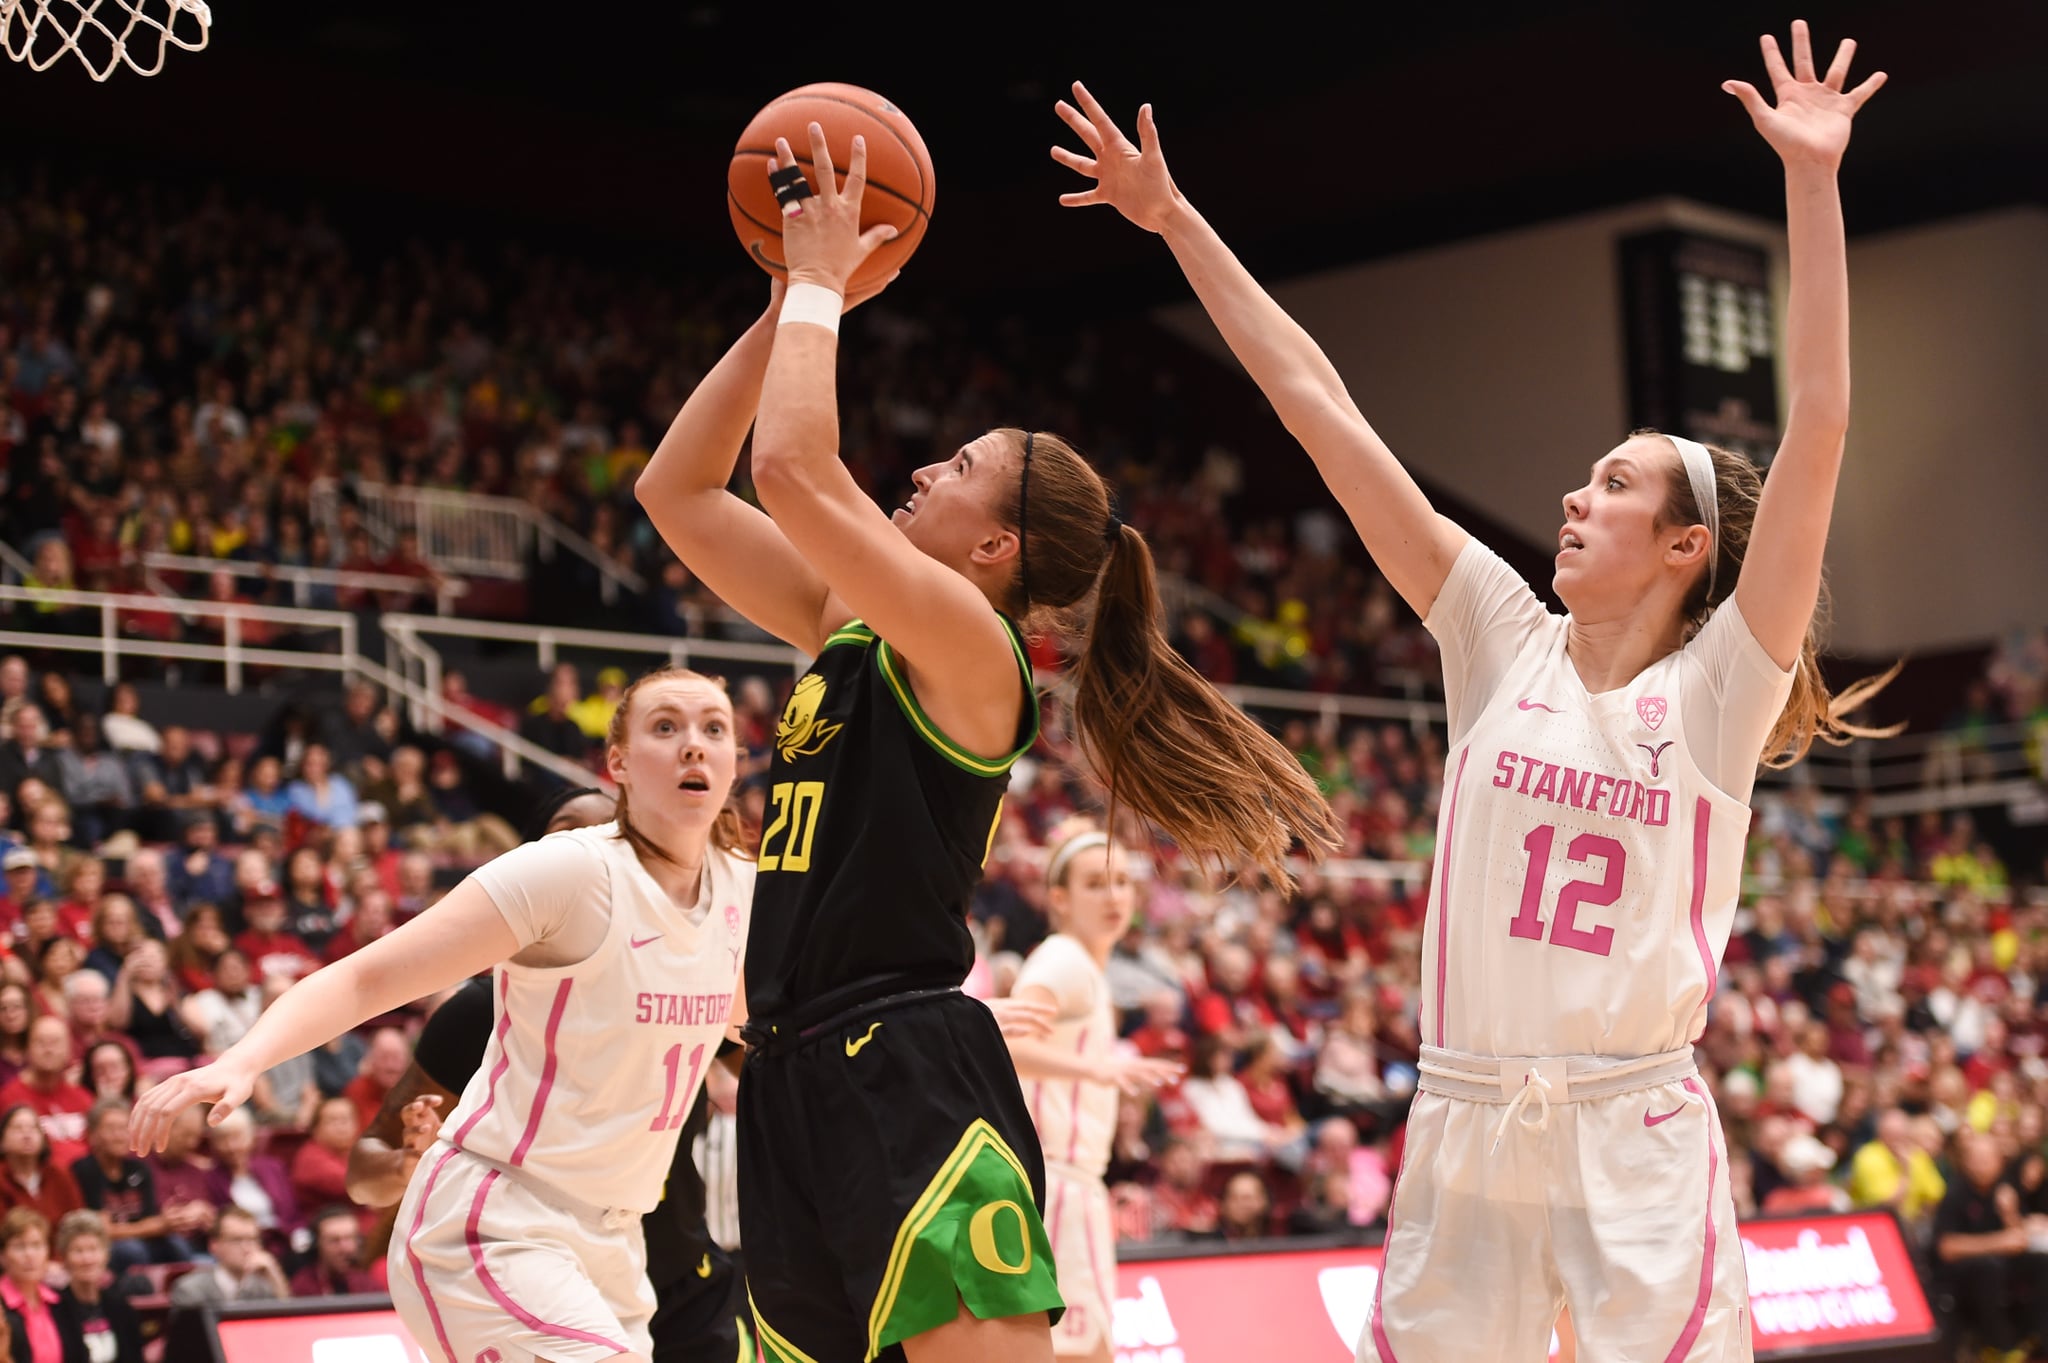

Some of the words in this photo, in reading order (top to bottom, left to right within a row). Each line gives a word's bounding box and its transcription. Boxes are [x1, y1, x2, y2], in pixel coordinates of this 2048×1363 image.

[1646, 711, 1659, 722] 12
[757, 781, 825, 872] 20
[1492, 751, 1670, 827] STANFORD
[1510, 824, 1626, 956] 12
[649, 1043, 704, 1131] 11
[969, 1200, 1031, 1274] O
